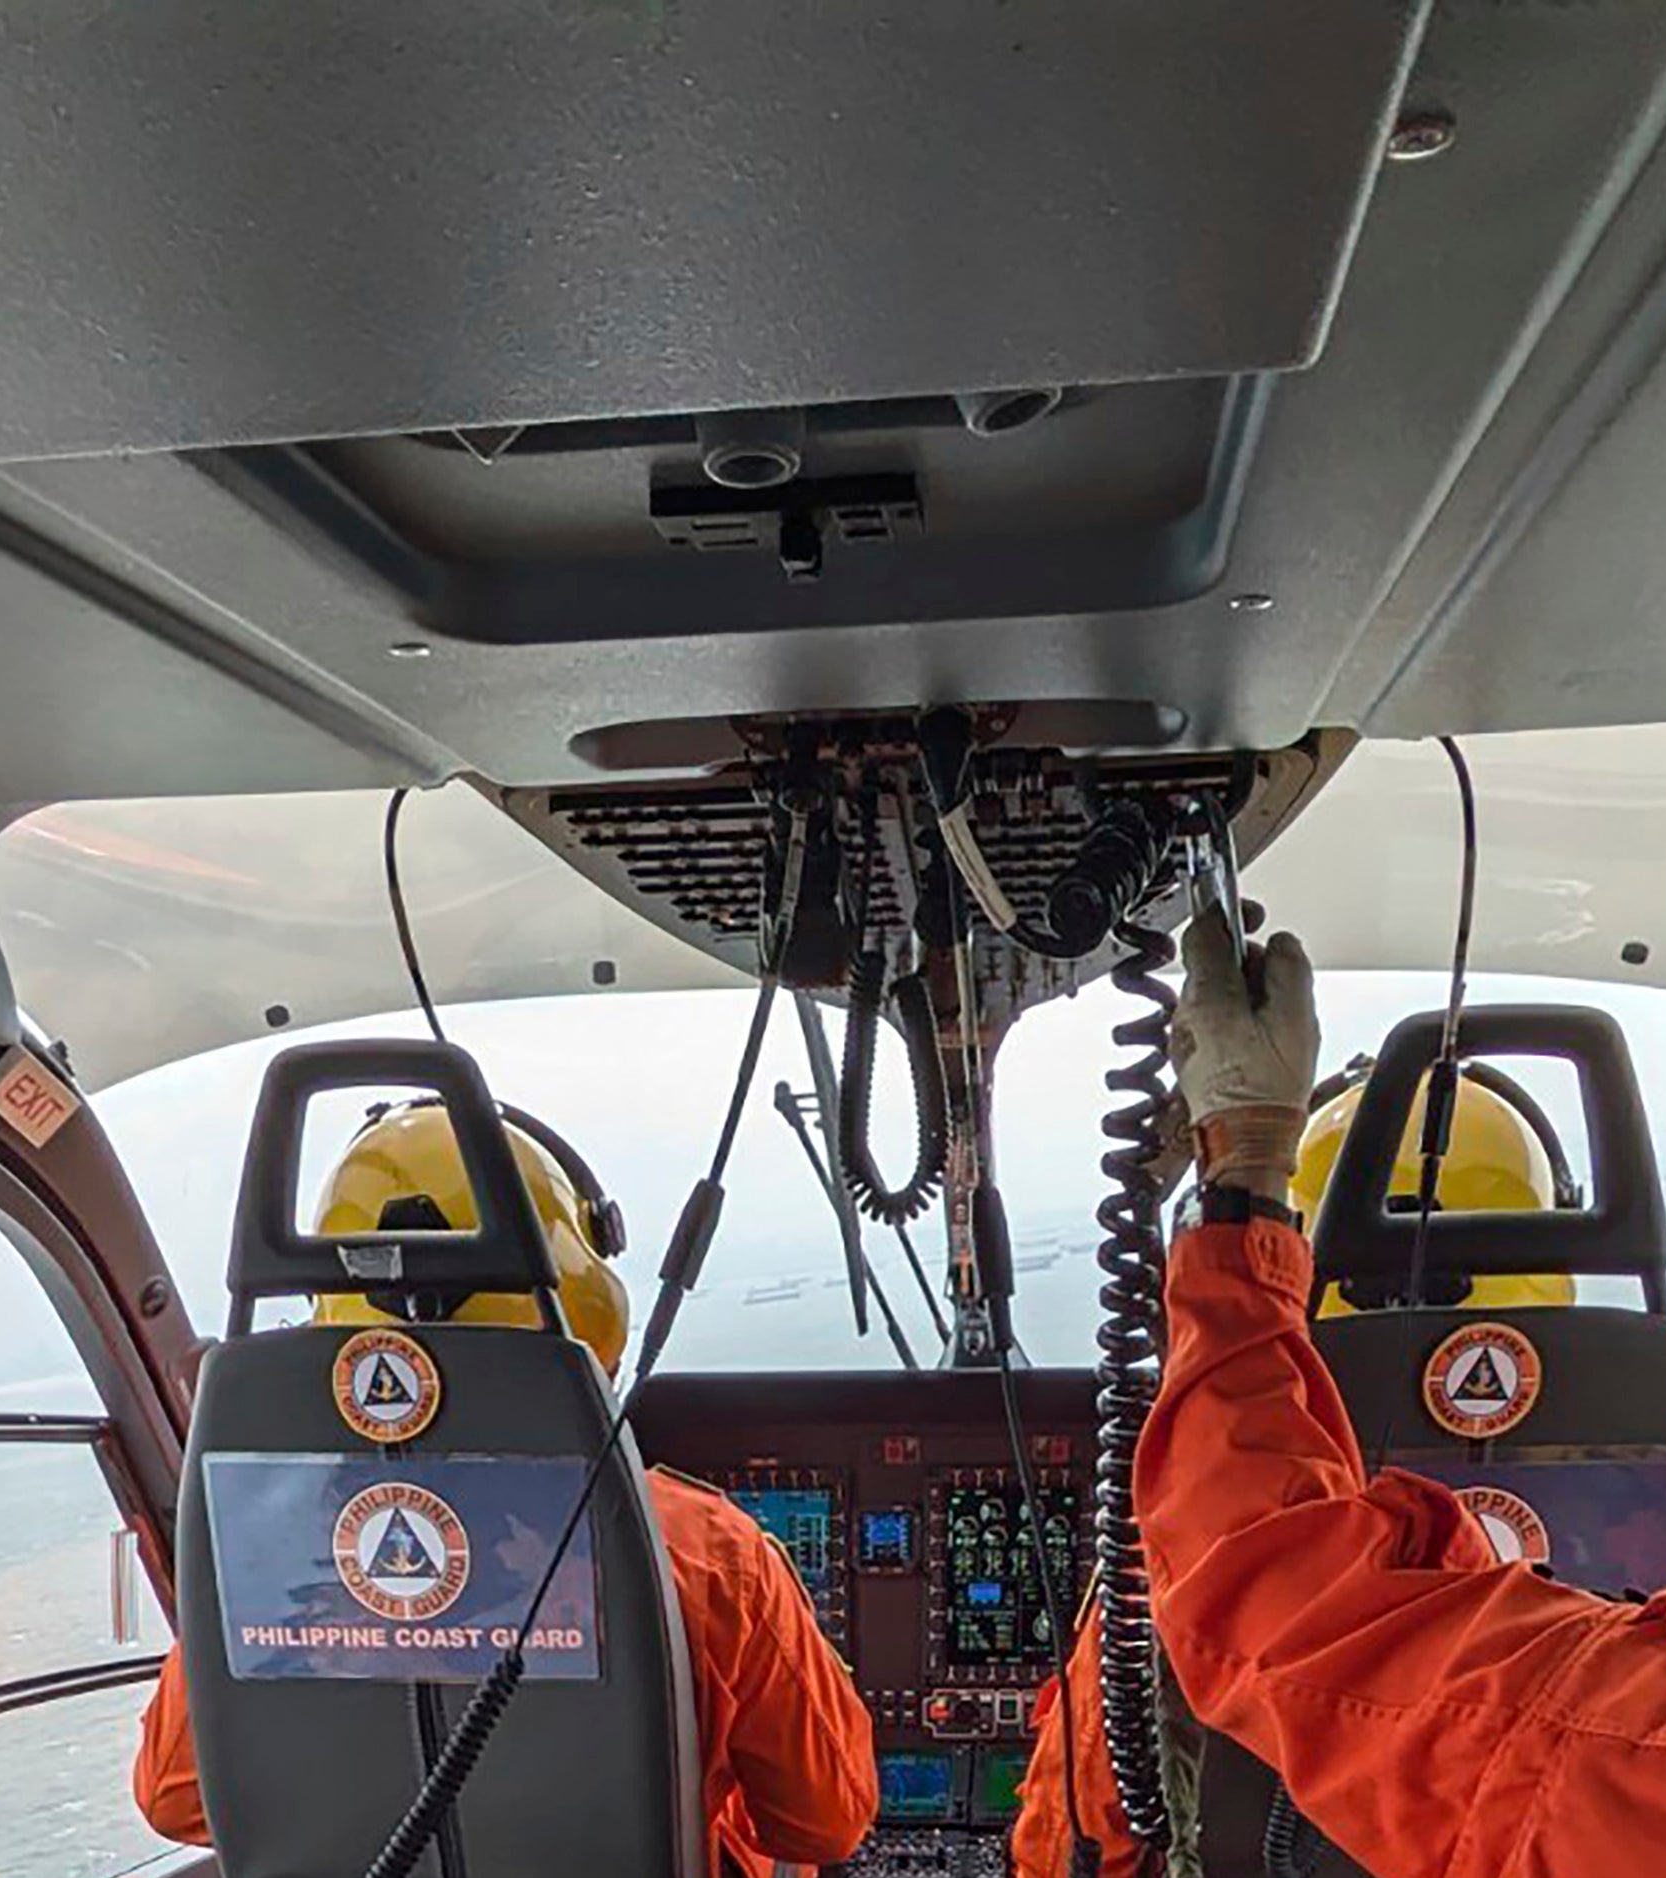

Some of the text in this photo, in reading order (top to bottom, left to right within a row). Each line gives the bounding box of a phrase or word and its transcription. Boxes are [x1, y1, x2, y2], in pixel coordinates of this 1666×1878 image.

[5, 1073, 65, 1128] EXIT
[339, 1486, 461, 1534] PHILIPPINE
[340, 1555, 466, 1617] COAST GUARD
[242, 1627, 387, 1648] PHILIPPINE
[395, 1627, 482, 1648] COAST
